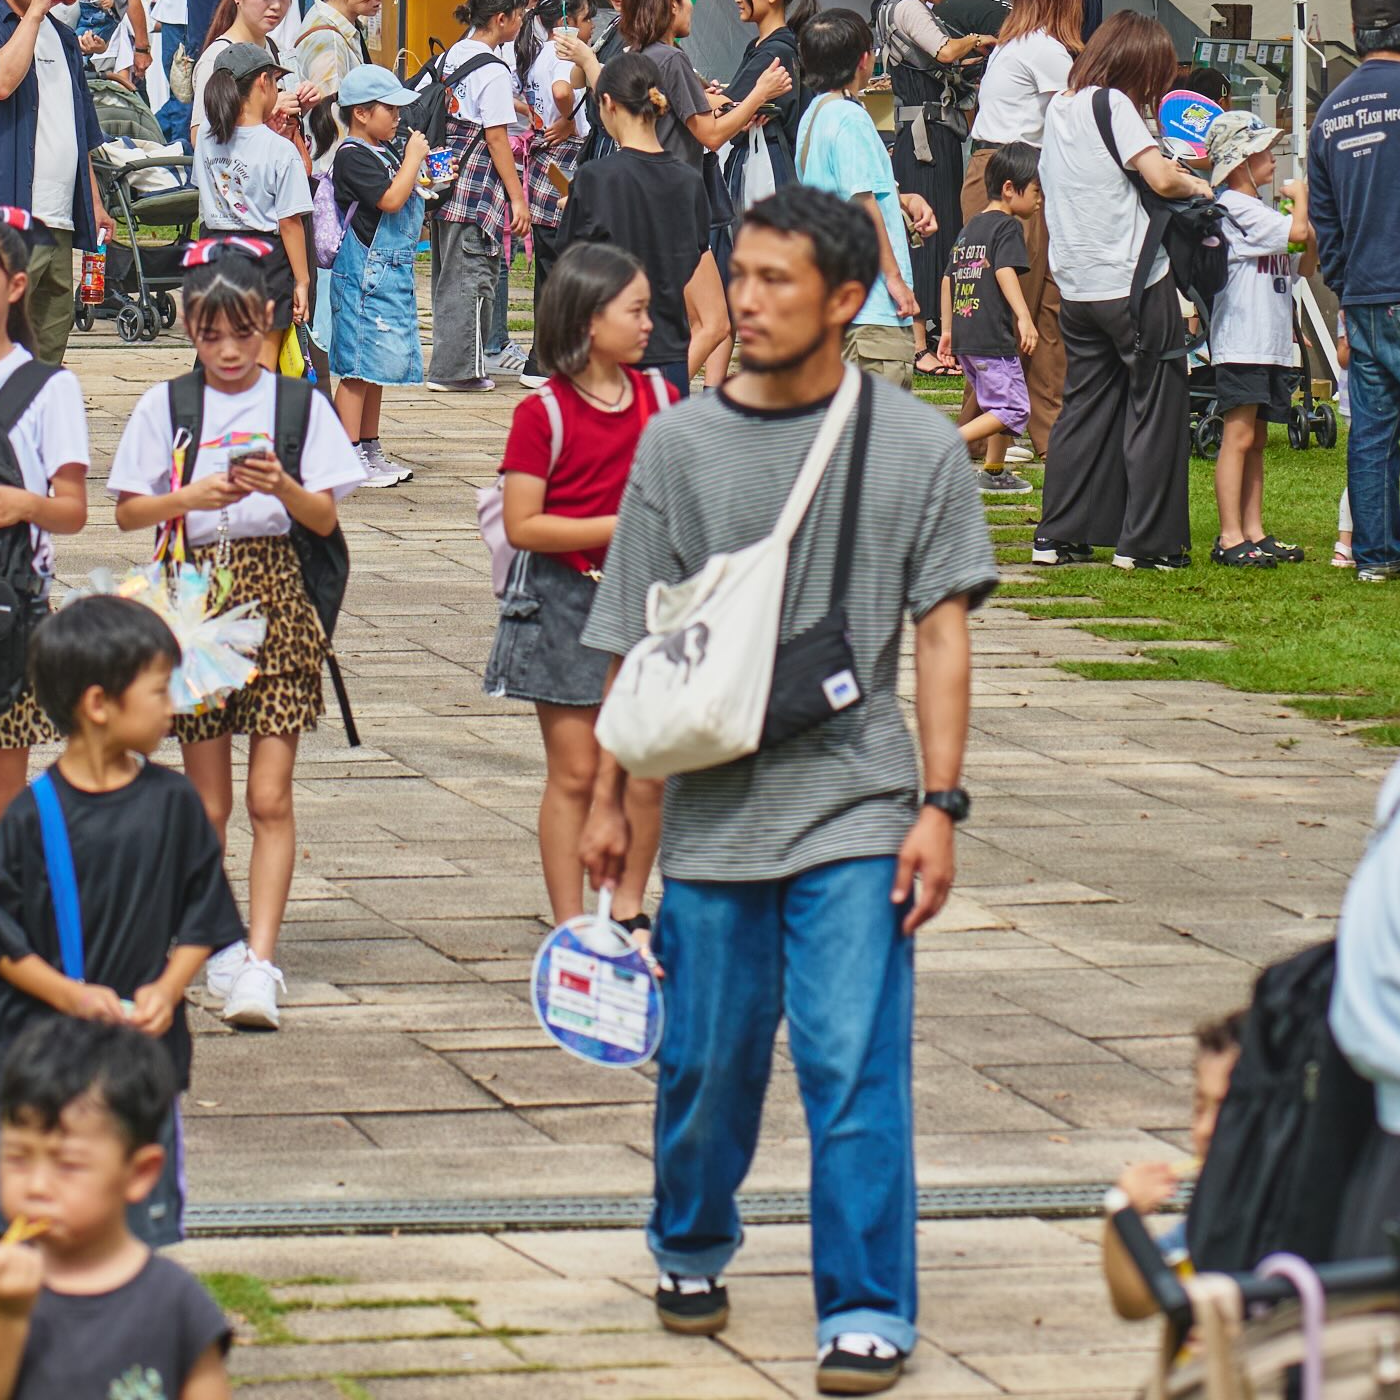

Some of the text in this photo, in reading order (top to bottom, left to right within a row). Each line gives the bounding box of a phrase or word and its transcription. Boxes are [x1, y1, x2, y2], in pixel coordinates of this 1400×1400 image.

[1333, 92, 1388, 110] MADE OF GENUINE
[1321, 114, 1355, 139] GOLDEN
[1355, 108, 1382, 129] FLASH
